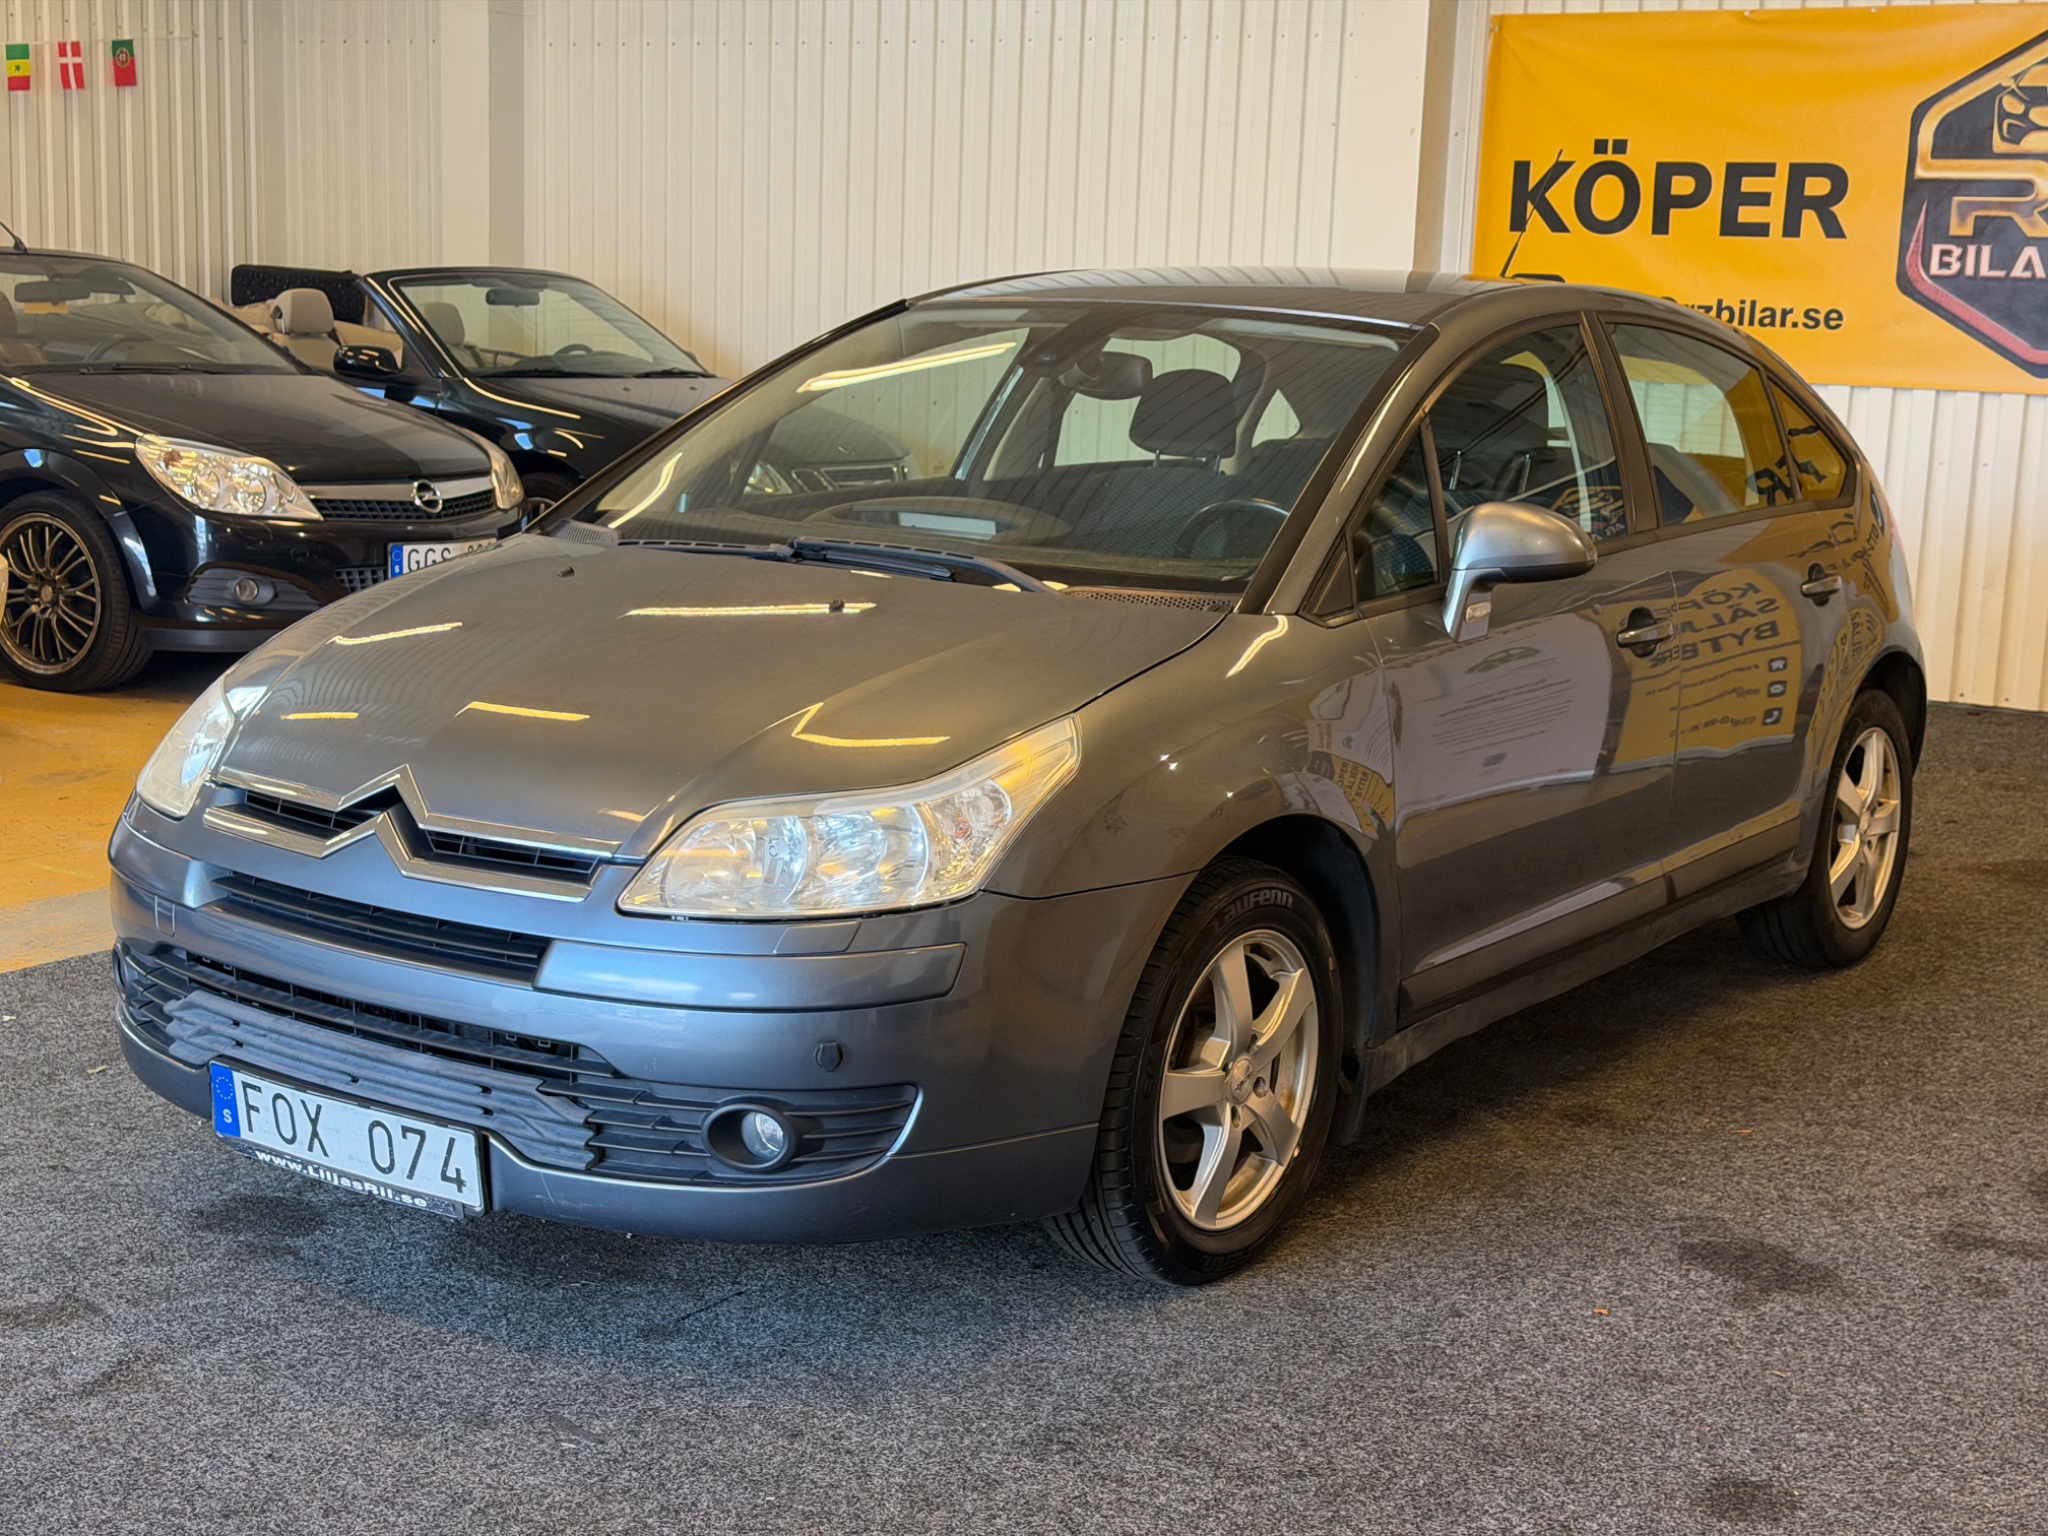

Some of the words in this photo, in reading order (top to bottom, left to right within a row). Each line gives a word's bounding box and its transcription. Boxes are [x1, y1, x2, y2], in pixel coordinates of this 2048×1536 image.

[1509, 138, 1849, 239] KÖPER
[1661, 296, 1844, 330] zbilar.se
[222, 1108, 233, 1124] S
[241, 1081, 330, 1158] FOX
[368, 1119, 467, 1194] 074
